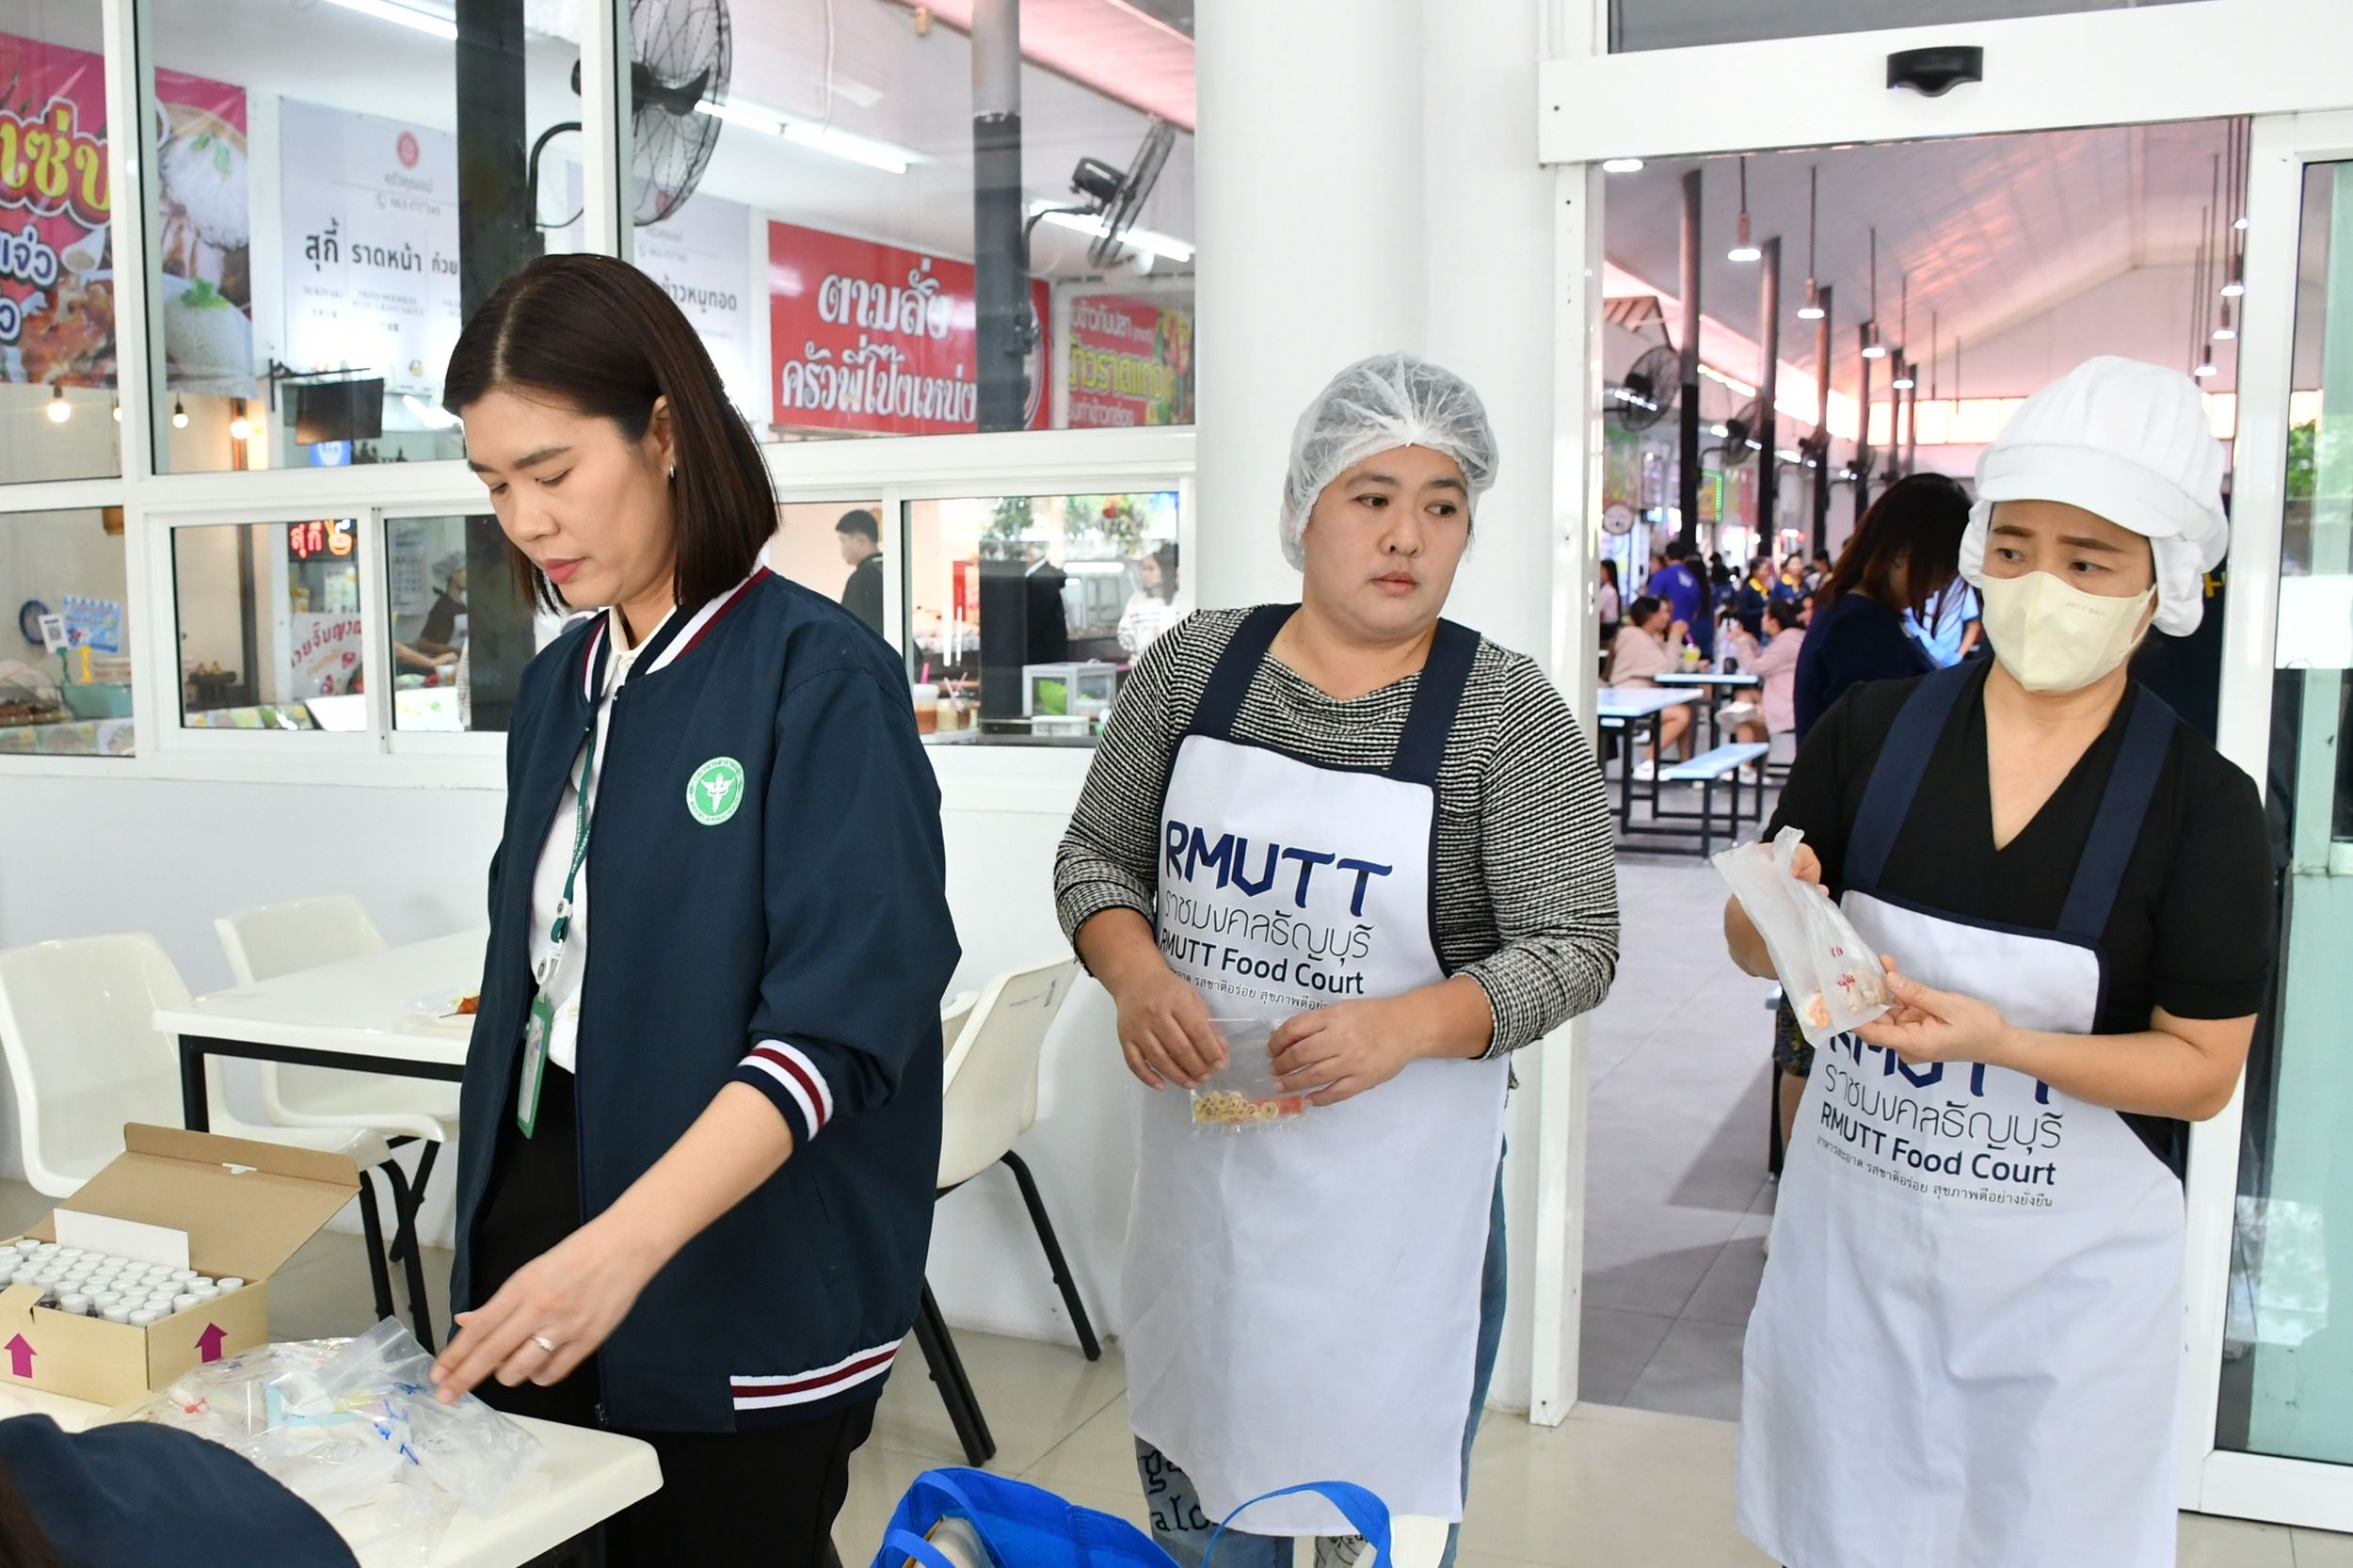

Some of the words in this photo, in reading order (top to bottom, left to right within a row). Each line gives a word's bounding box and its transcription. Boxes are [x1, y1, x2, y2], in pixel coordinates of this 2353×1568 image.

[306, 217, 339, 272] สุกี้
[352, 242, 422, 273] ราดหน้า
[818, 257, 952, 340] ตามสั่ง
[1166, 820, 1393, 918] RMUTT
[1160, 927, 1217, 968] RMUTT
[1221, 947, 1289, 984] Food
[1295, 962, 1365, 995] Court
[1165, 889, 1375, 968] ราชมงคลธัญบุรี
[1820, 1100, 1887, 1156] RMUTT
[1891, 1136, 1962, 1176] Food
[1971, 1153, 2057, 1186] Court
[1824, 1064, 2064, 1157] ราชมงคลธัญบุรี
